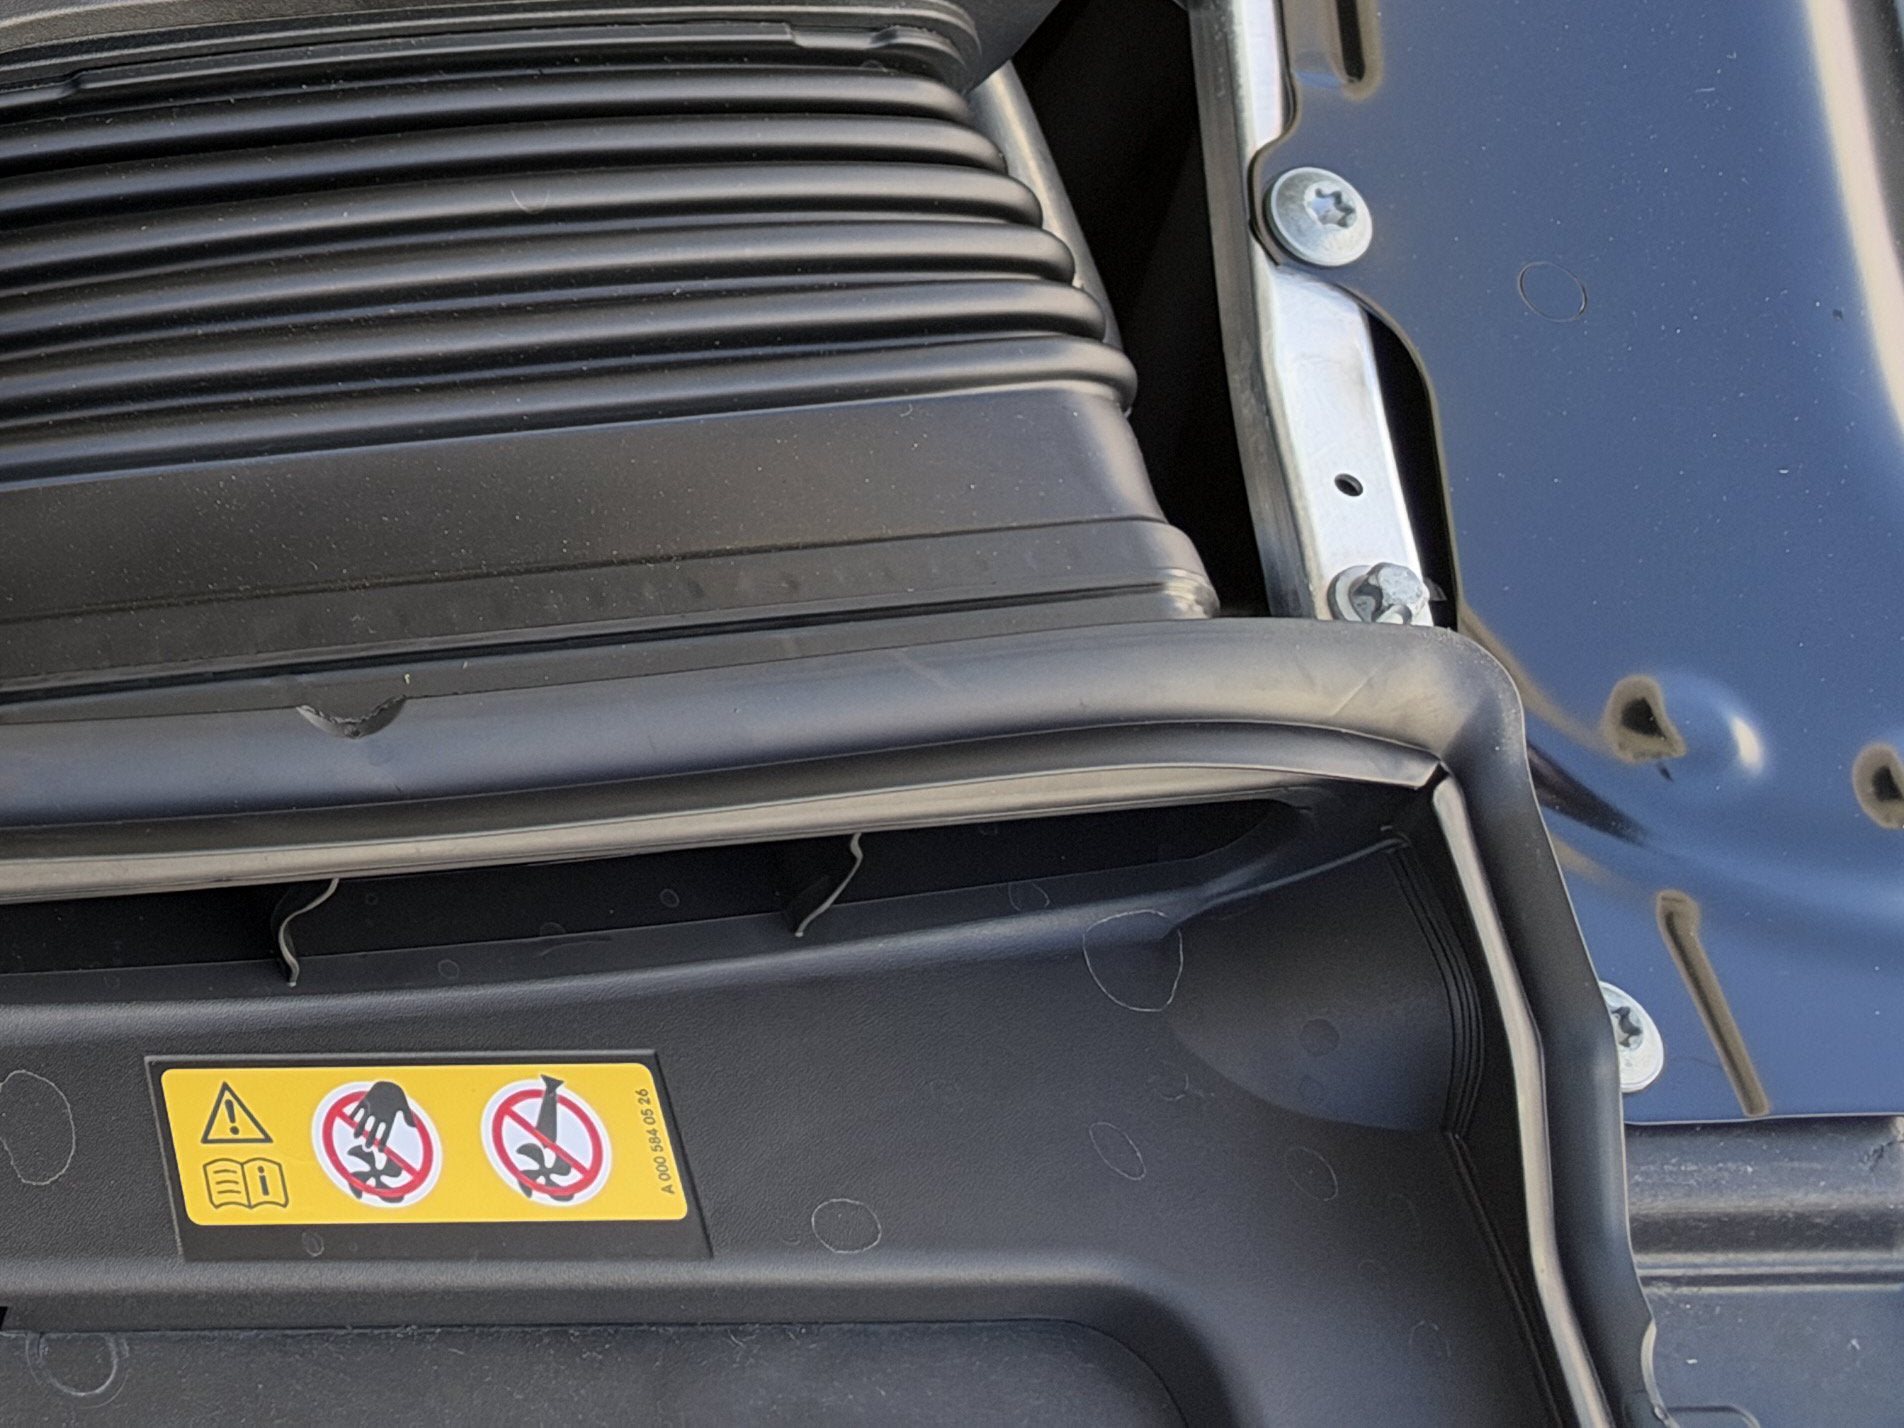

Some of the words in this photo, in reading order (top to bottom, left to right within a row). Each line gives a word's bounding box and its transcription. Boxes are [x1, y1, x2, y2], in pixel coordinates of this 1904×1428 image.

[635, 1088, 651, 1105] 26
[641, 1108, 656, 1125] 05
[646, 1128, 664, 1153] 584
[653, 1156, 671, 1181] 000
[661, 1184, 675, 1194] A
